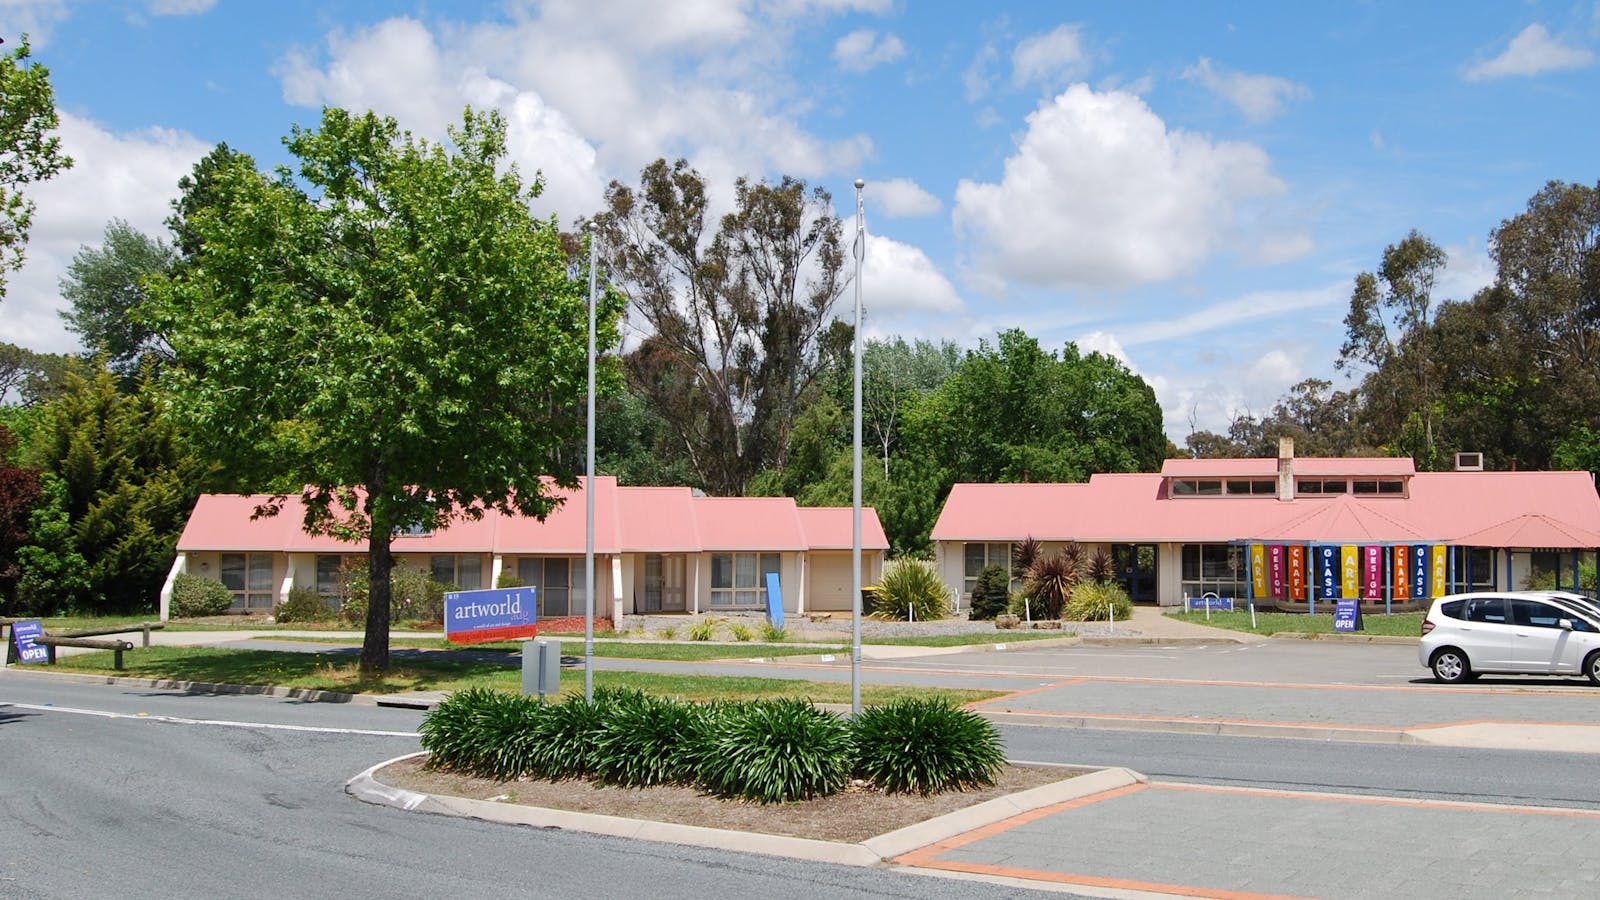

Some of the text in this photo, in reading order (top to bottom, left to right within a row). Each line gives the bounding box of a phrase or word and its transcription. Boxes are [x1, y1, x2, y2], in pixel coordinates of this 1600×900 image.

[1254, 555, 1262, 588] ART
[1272, 548, 1281, 594] DESIGN
[1292, 549, 1300, 596] CRAFT
[1323, 549, 1333, 597] GLASS
[1345, 556, 1355, 591] ART
[1368, 548, 1377, 597] DESIGN
[1397, 548, 1405, 596] CRAFT
[1416, 548, 1425, 596] GLASS
[1435, 555, 1444, 589] ART
[455, 593, 520, 619] artworld
[1336, 620, 1354, 628] OPEN
[22, 648, 48, 660] OPEN
